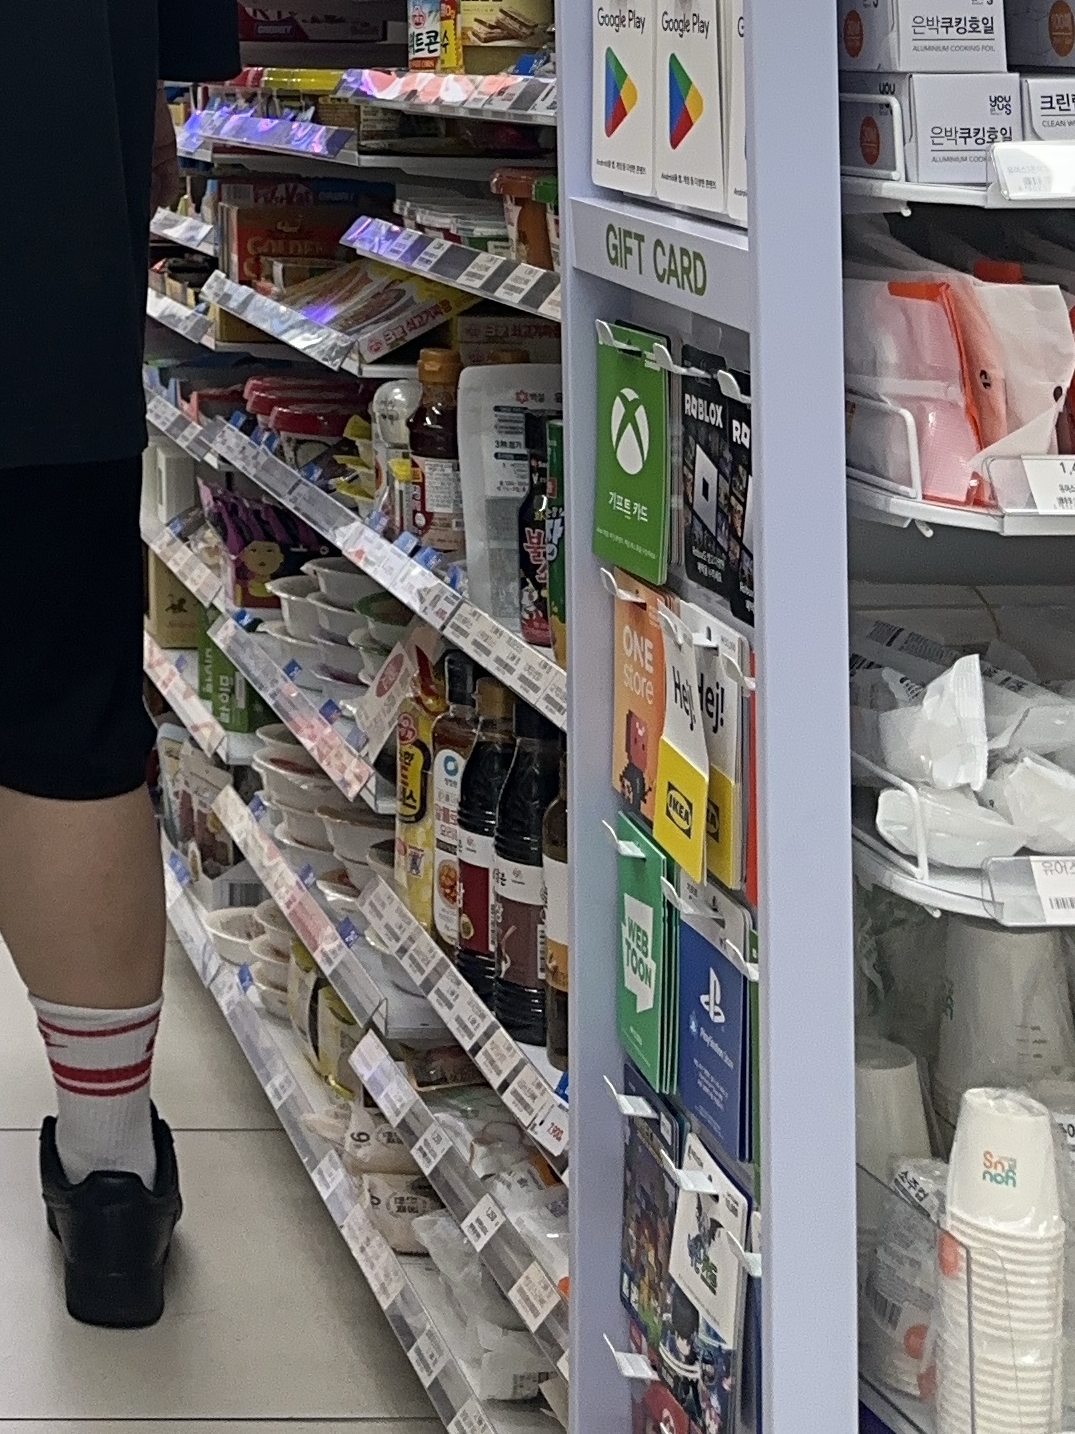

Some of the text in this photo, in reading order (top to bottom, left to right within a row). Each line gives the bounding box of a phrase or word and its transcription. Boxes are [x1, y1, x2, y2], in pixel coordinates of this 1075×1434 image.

[597, 6, 646, 34] Google Play
[662, 11, 690, 39] Google
[692, 13, 710, 40] Play
[911, 15, 995, 35] 은박쿠킹호일
[912, 44, 996, 53] ALUMINIUM COOKING FOIL
[988, 95, 1012, 107] you
[930, 126, 1013, 146] 은박쿠킹호일
[1041, 120, 1064, 128] CLEAN
[931, 155, 968, 163] ALUMINIUM
[606, 223, 707, 297] GIFT CARD
[684, 393, 724, 429] ROBLOX
[732, 419, 751, 443] RO
[609, 491, 649, 523] 기프트 카드
[623, 624, 654, 675] ONE
[623, 664, 655, 705] store
[668, 794, 690, 827] IKEA
[626, 917, 650, 960] WEB
[625, 942, 652, 990] TOON
